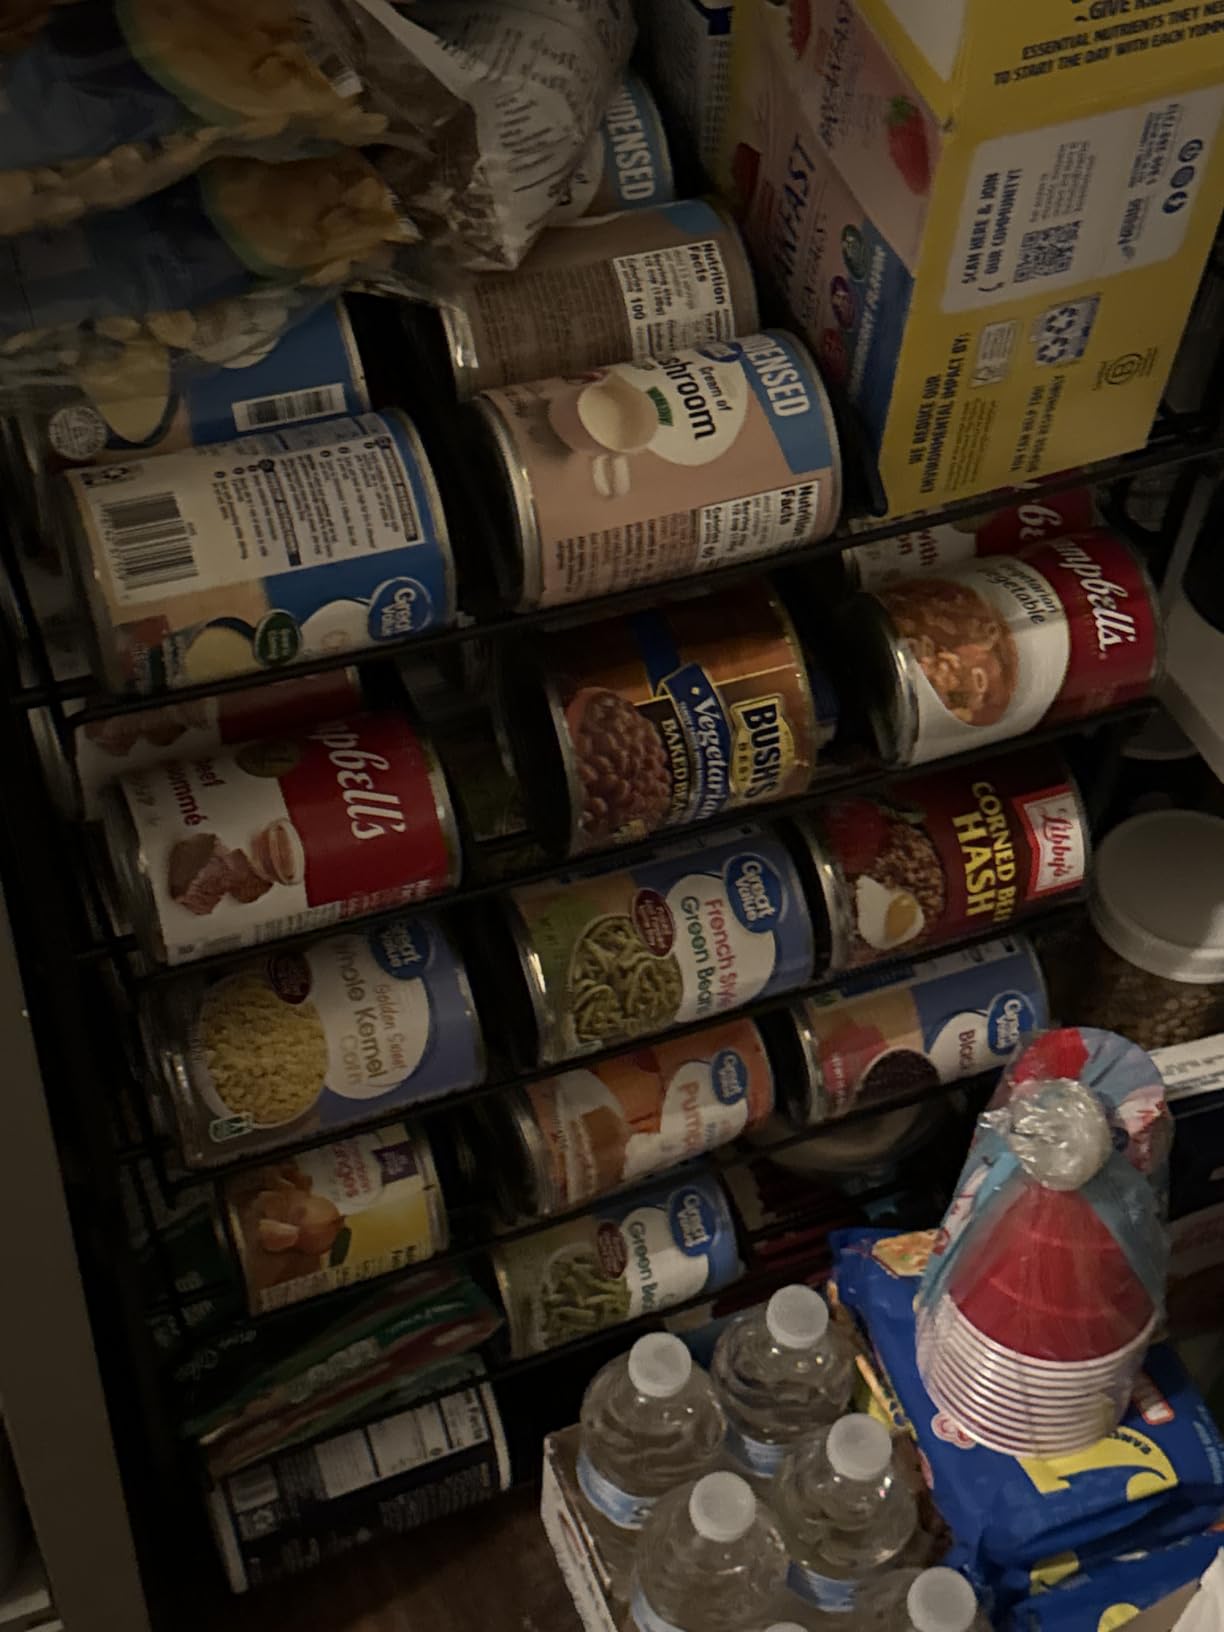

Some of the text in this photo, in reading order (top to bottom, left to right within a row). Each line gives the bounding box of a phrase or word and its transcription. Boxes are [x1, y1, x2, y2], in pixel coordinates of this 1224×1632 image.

[994, 71, 1010, 85] TO
[1013, 60, 1053, 82] START
[1057, 52, 1082, 70] THE
[1085, 47, 1112, 64] DAY
[1115, 37, 1150, 56] WITH
[1151, 29, 1186, 48] EACH
[1022, 32, 1090, 60] ESSENTIAL
[1094, 14, 1165, 41] NUTRIENTS
[1168, 6, 1200, 25] THEY
[980, 172, 999, 200] JOIN
[969, 219, 990, 250] HERE
[688, 245, 708, 282] Facts
[702, 242, 725, 304] Nutrition
[961, 252, 981, 284] SCAN
[984, 249, 1004, 275] OUR
[701, 366, 734, 413] Cream of
[922, 373, 943, 400] OUR
[780, 489, 796, 525] Facts
[793, 484, 814, 537] Nutrition
[394, 586, 418, 635] Great
[660, 717, 690, 785] BAKED
[737, 741, 749, 783] BEST
[741, 702, 782, 799] BUSH'S
[971, 780, 1017, 882] CORNED
[1040, 808, 1074, 879] Libby's
[740, 859, 777, 920] Great
[951, 811, 996, 917] HASH
[734, 877, 759, 923] Value
[681, 895, 709, 964] Green
[703, 897, 738, 970] French
[353, 1008, 388, 1080] Kernel
[628, 1221, 653, 1285] Green
